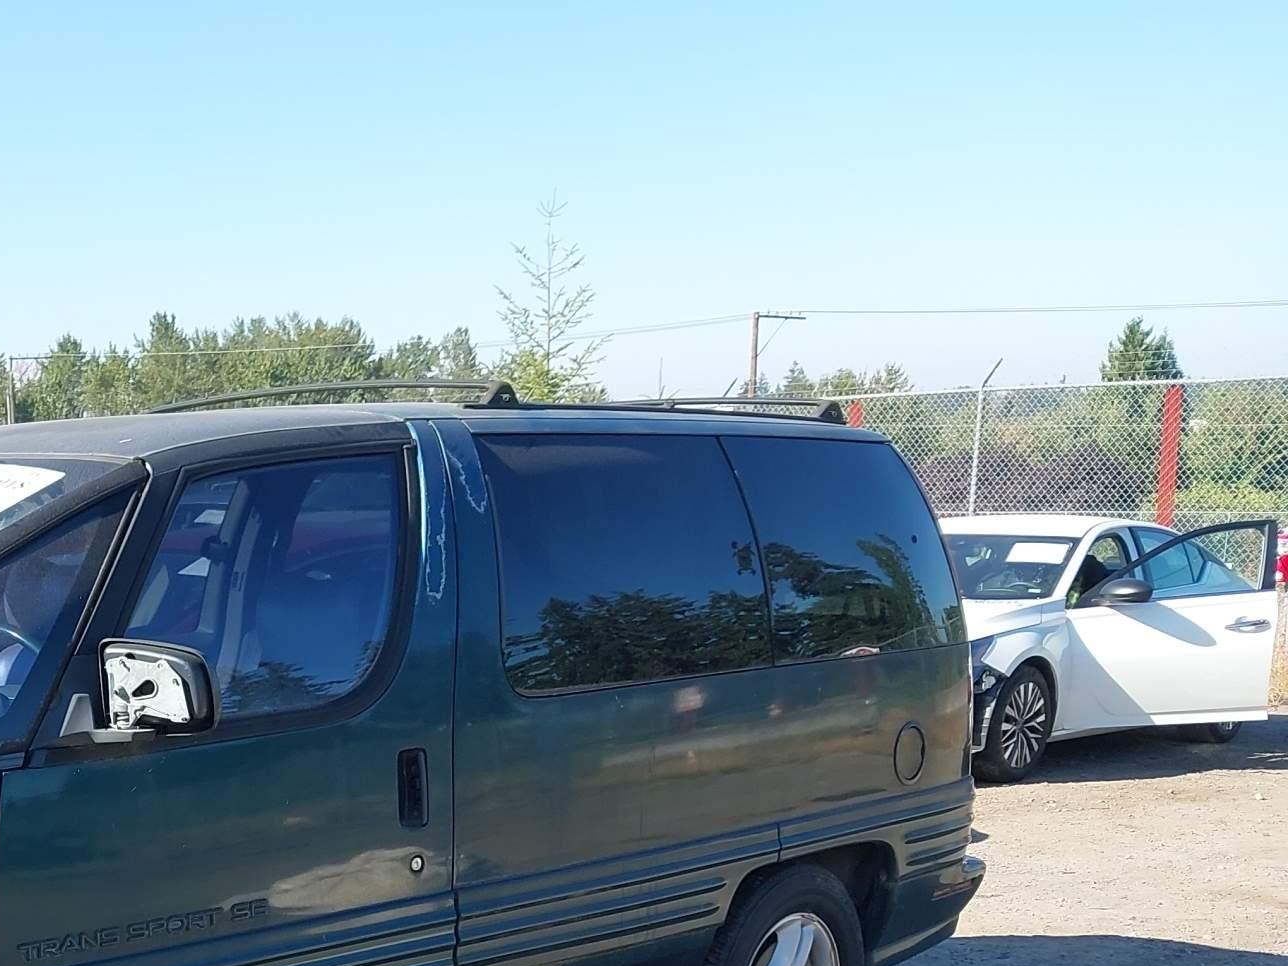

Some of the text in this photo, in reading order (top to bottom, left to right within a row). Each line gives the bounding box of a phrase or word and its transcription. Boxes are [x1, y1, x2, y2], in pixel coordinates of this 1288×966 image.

[16, 897, 269, 962] TRANS SPORT SE
